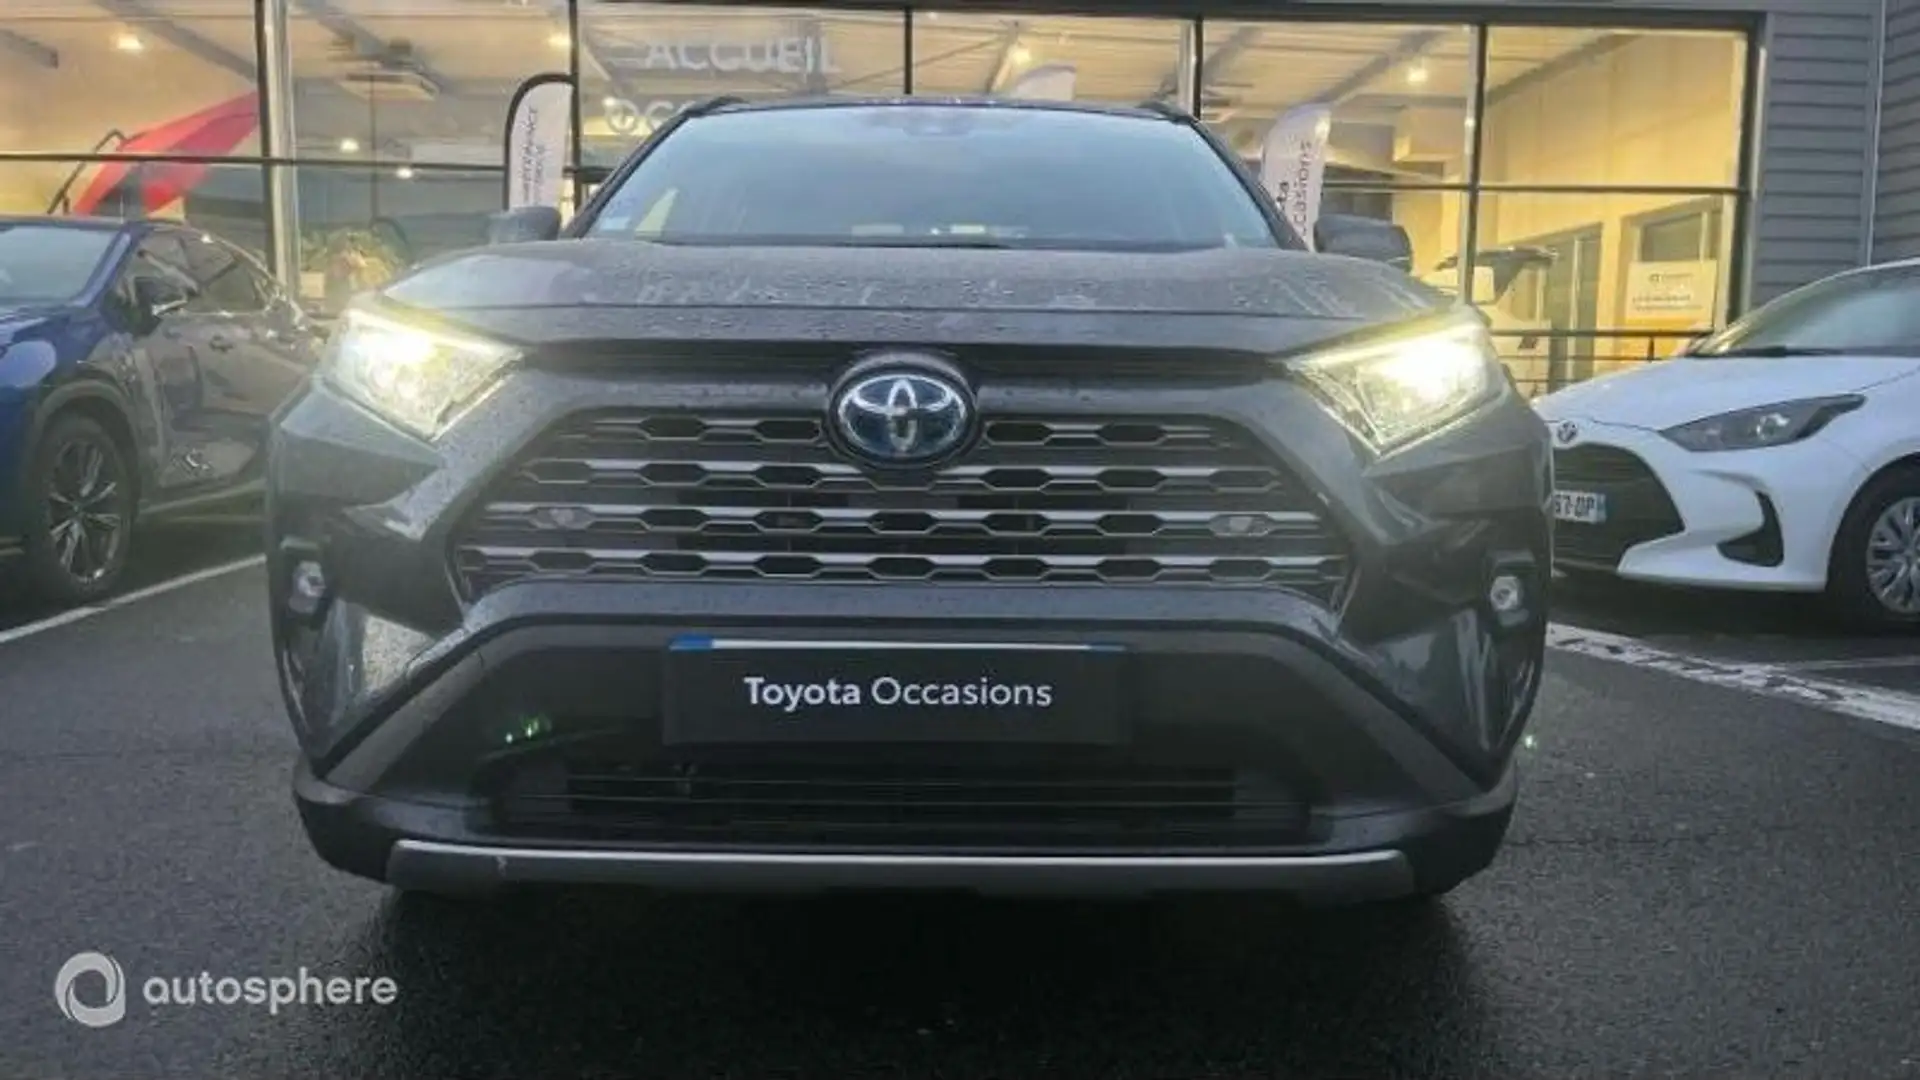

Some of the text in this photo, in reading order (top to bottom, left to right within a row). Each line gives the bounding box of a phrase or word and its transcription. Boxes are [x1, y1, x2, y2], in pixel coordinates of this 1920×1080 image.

[645, 35, 842, 73] ACCUEIL
[743, 675, 1053, 712] Toyota Occasions
